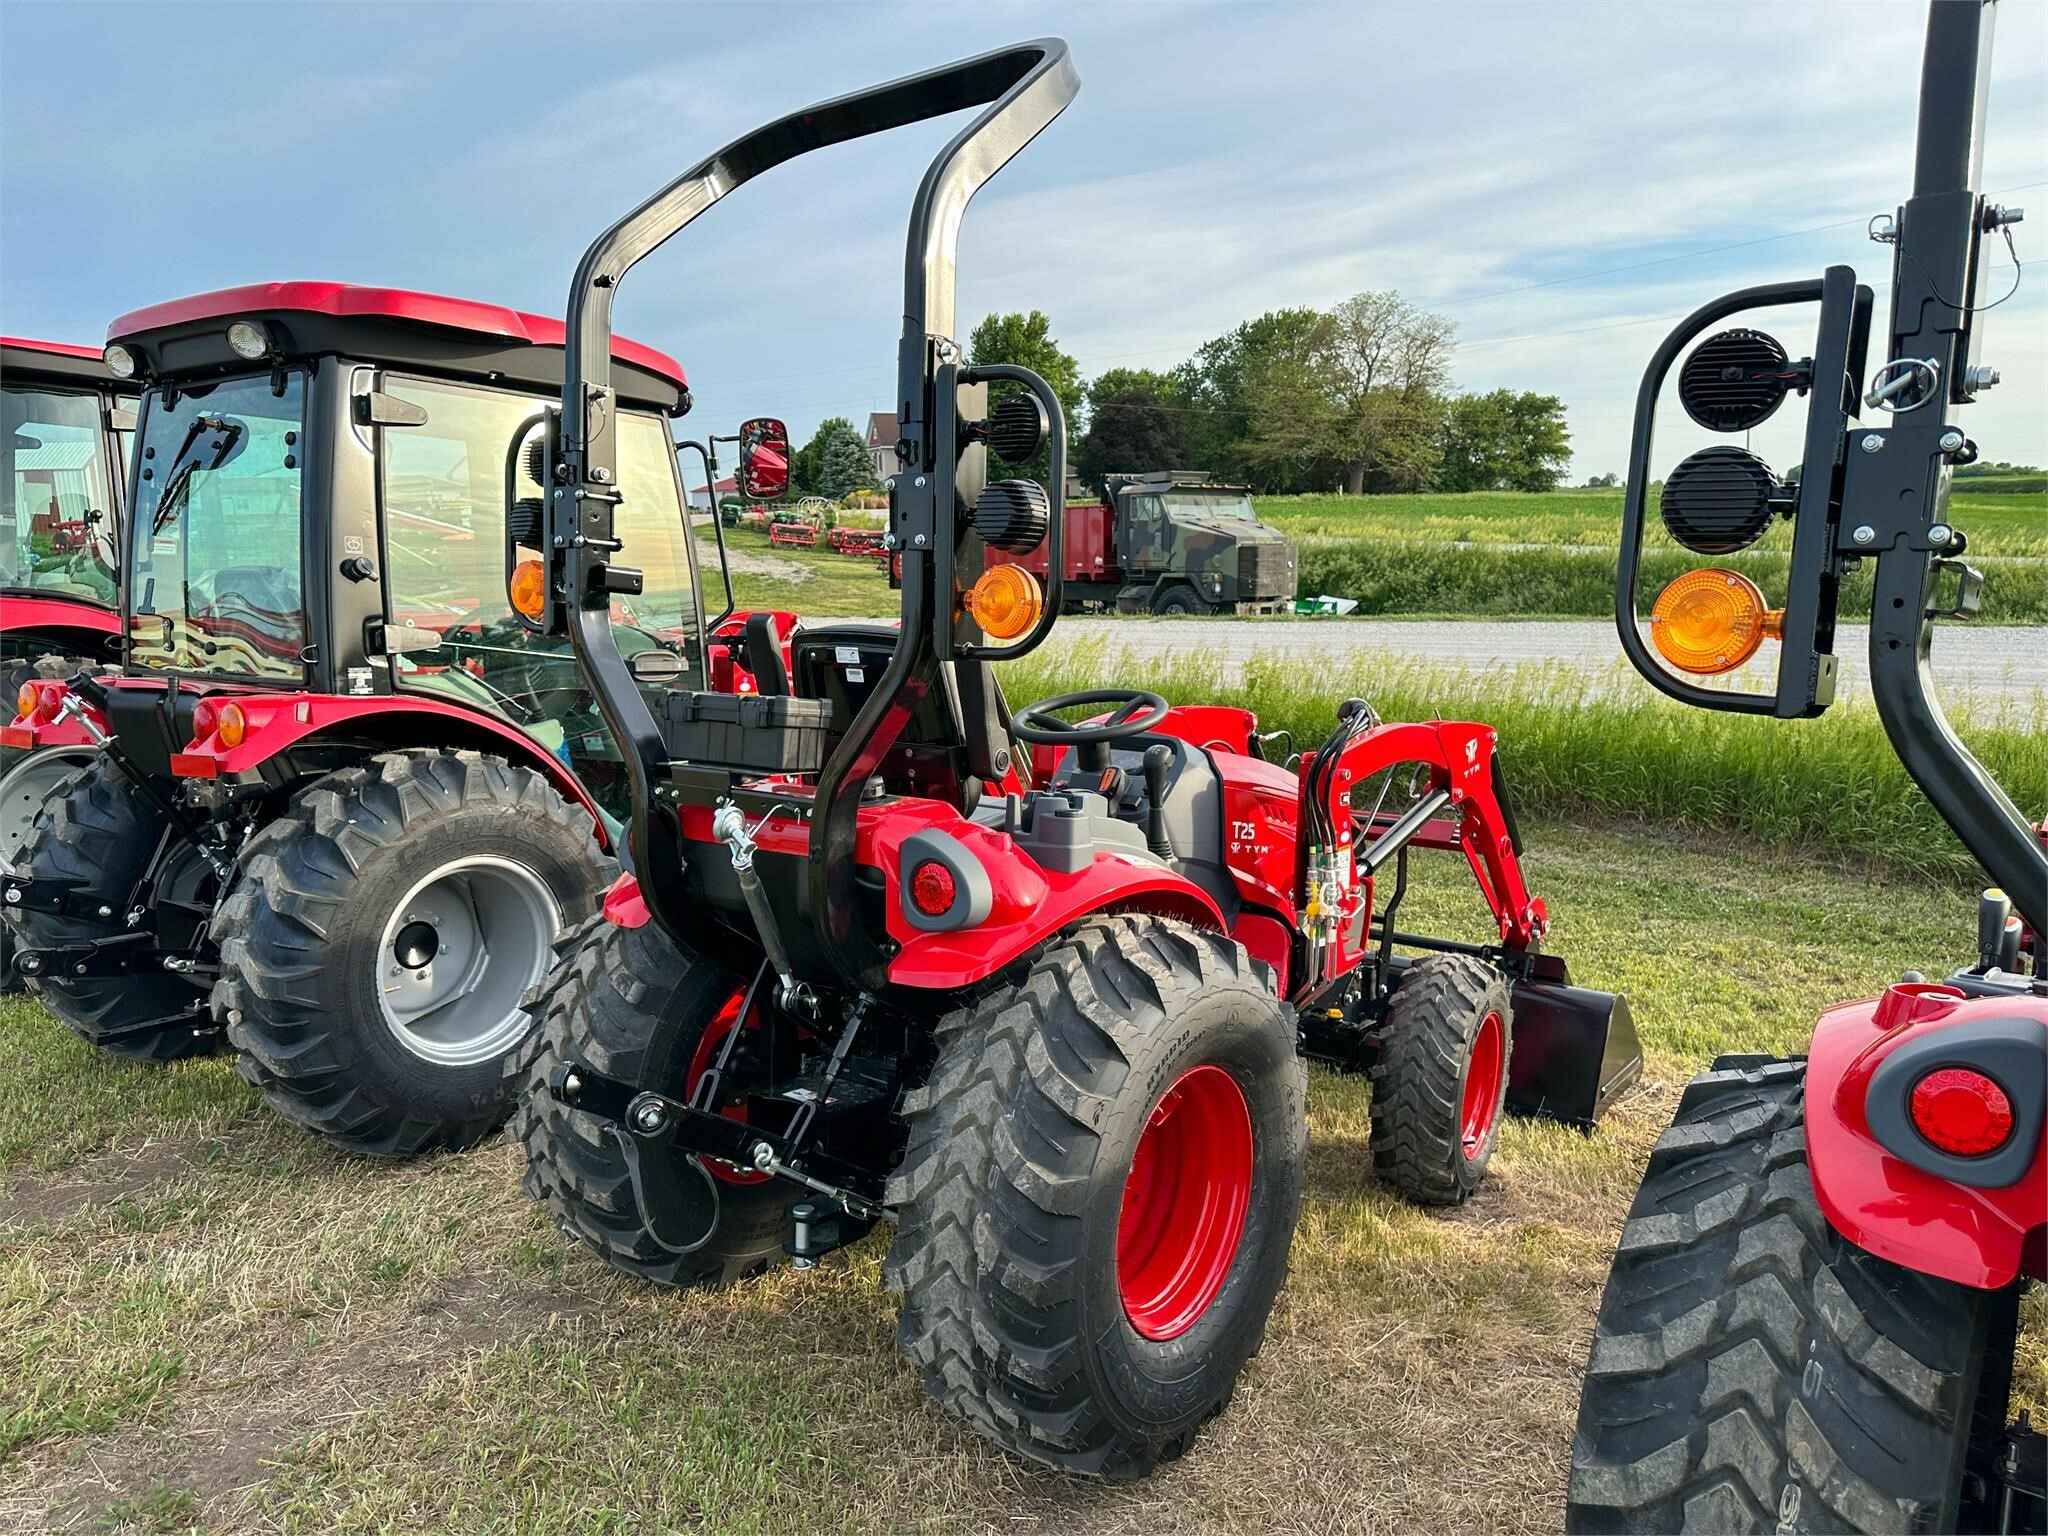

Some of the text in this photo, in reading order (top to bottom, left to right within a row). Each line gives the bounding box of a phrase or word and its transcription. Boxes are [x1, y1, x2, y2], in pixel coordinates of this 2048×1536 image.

[1464, 763, 1480, 778] TYM
[1232, 821, 1255, 840] T25
[1245, 845, 1268, 854] TYM
